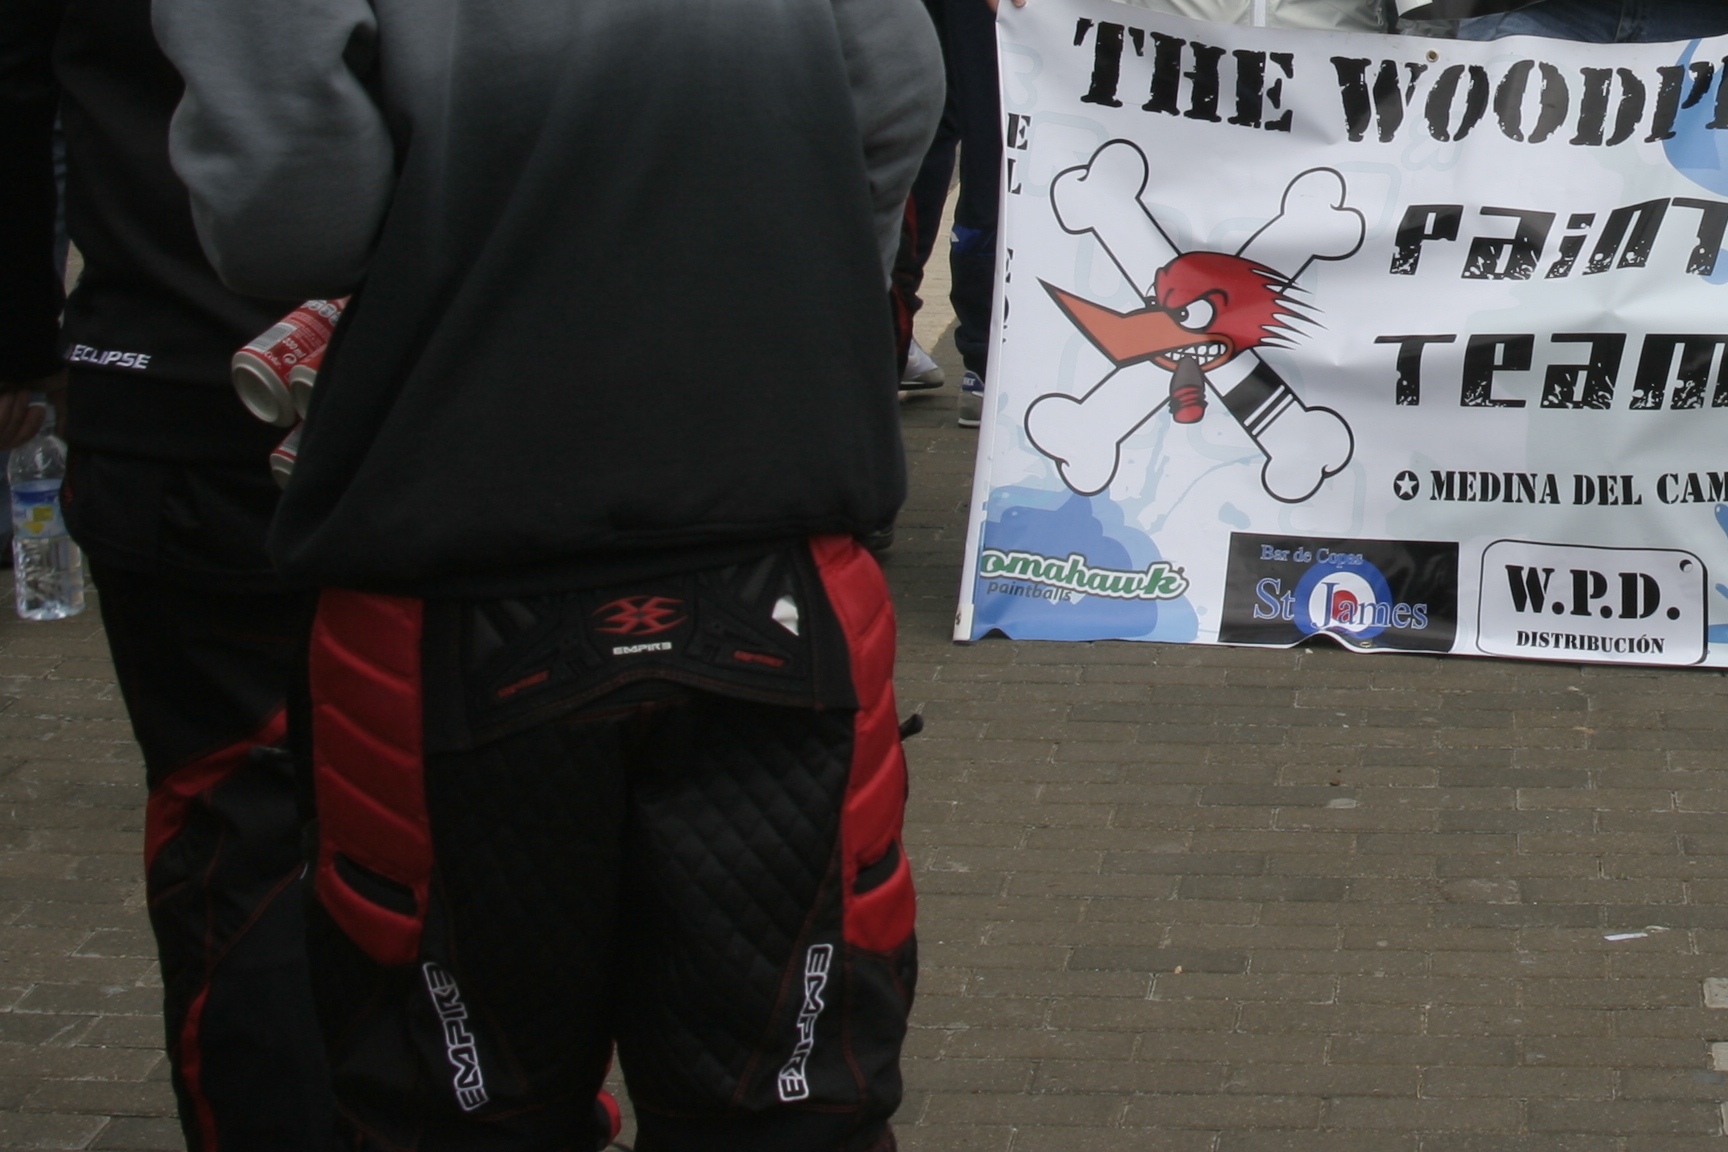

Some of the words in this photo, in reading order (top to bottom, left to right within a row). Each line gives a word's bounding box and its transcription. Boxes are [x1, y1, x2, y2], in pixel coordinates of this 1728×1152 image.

[1073, 17, 1294, 133] THE
[70, 344, 152, 369] ECLIPSE
[1429, 470, 1560, 505] MEDINA
[1573, 474, 1642, 506] DEL
[980, 548, 1188, 599] omahawk
[1260, 544, 1290, 562] Bar
[1293, 547, 1312, 563] de
[1316, 548, 1364, 567] Copas
[987, 580, 1073, 602] paintballs
[1253, 577, 1295, 621] St
[1311, 581, 1428, 629] James
[1505, 564, 1680, 620] W.P.D.
[1516, 630, 1665, 654] DISTRIBUCIÓN
